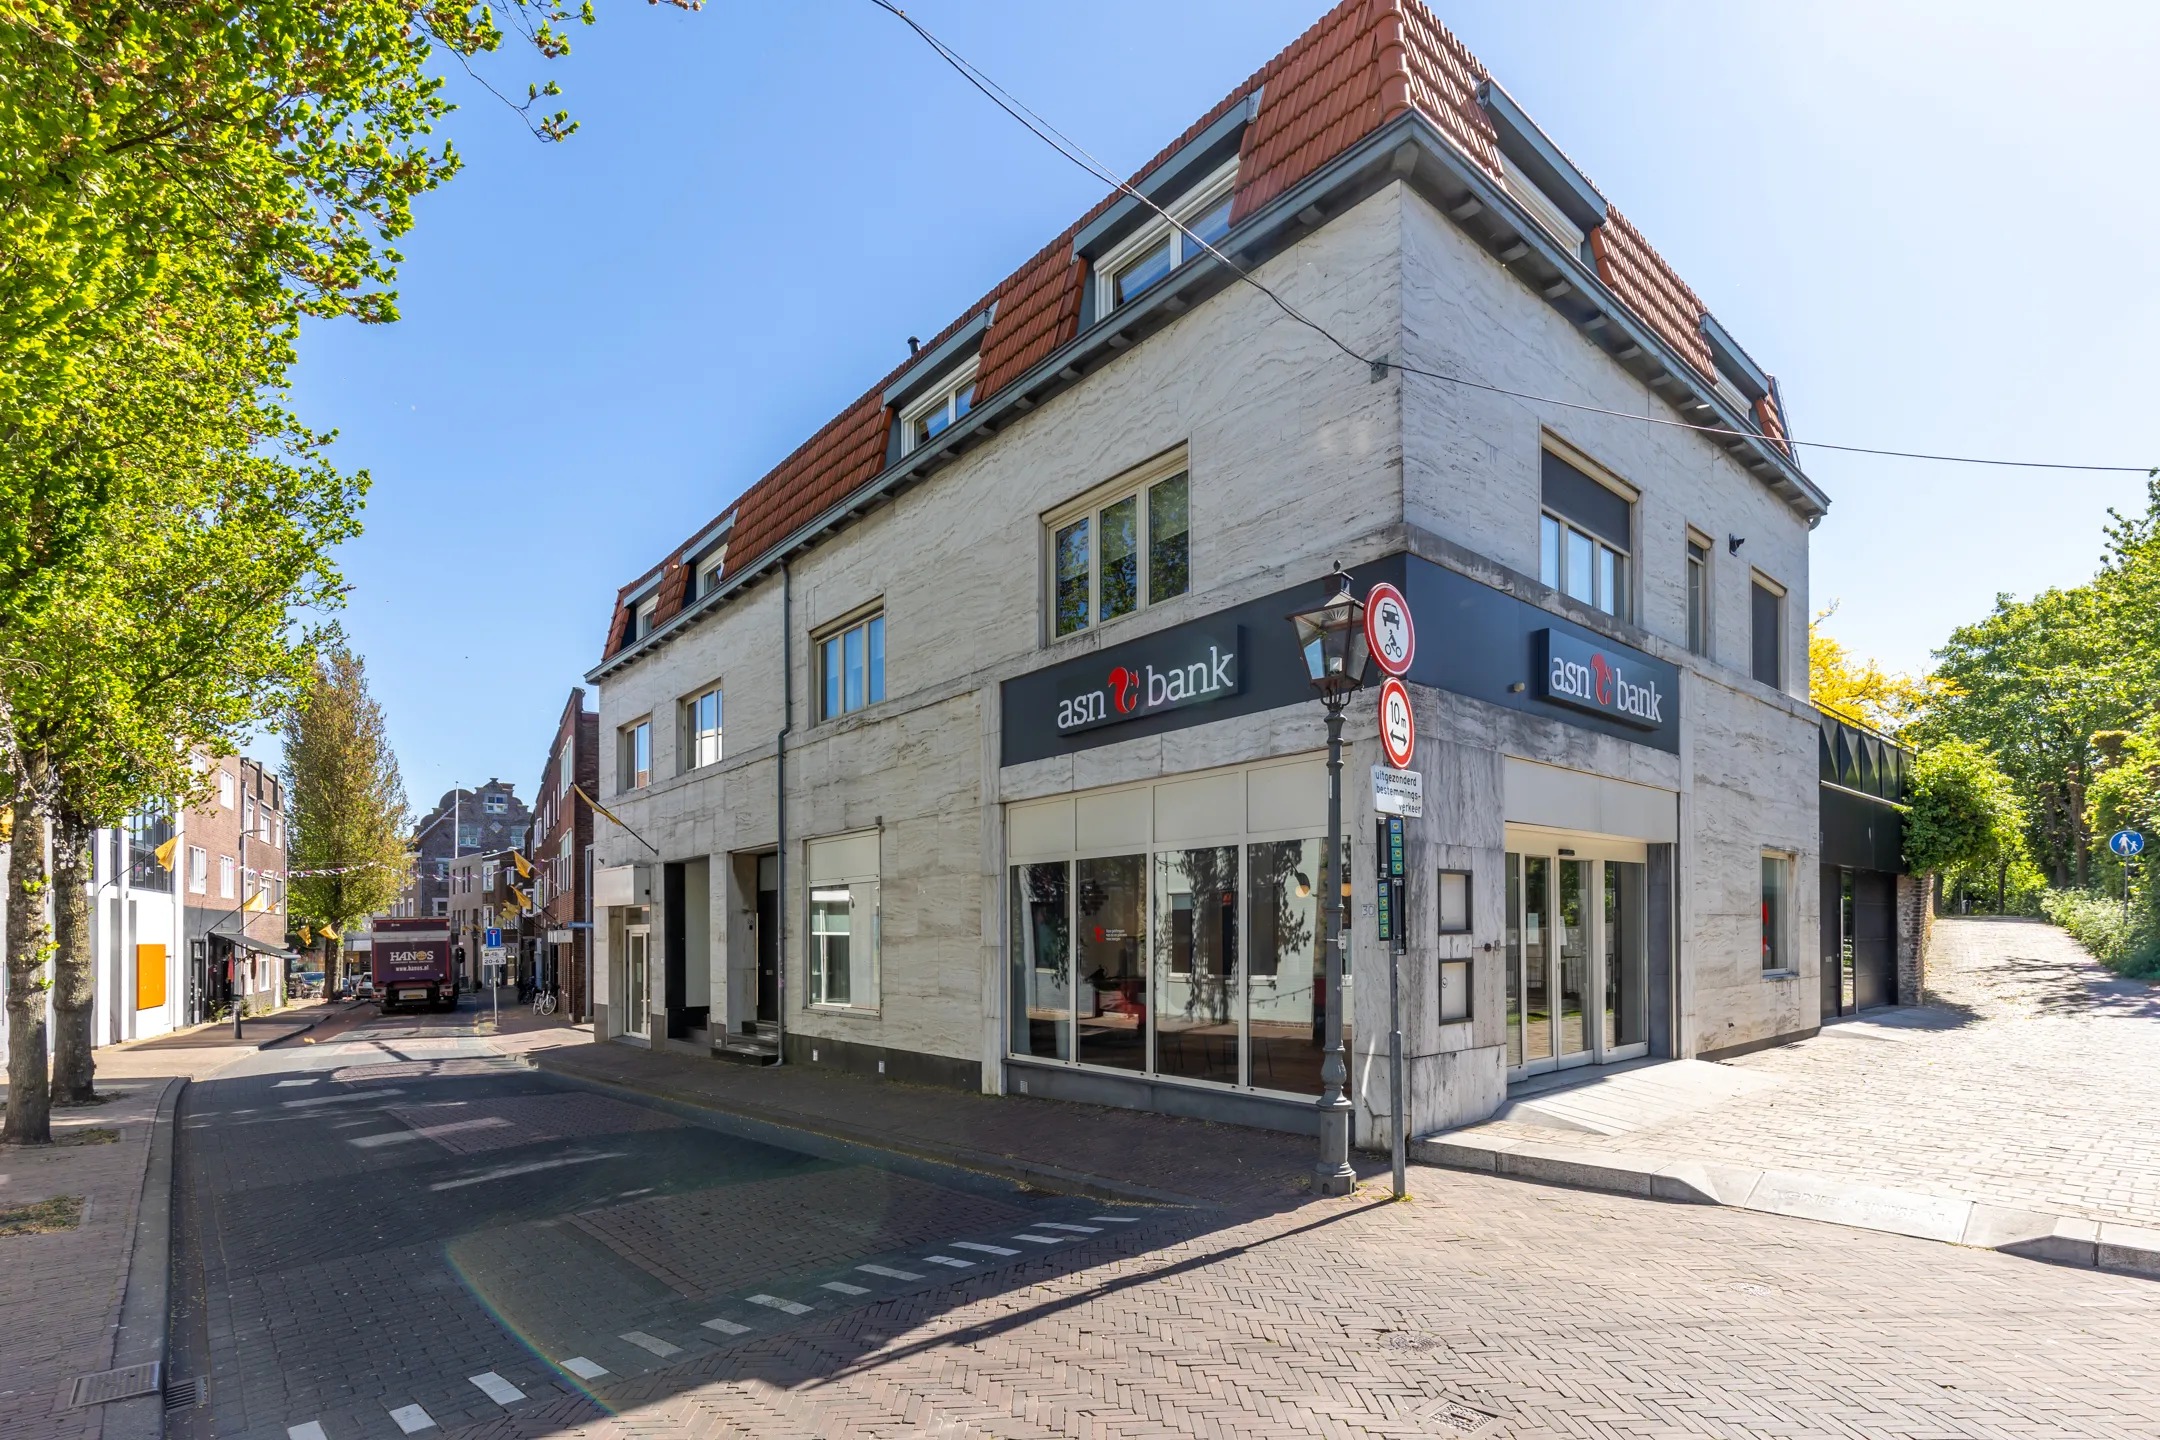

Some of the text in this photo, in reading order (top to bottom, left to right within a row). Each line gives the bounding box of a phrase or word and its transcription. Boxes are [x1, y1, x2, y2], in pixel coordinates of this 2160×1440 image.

[1058, 646, 1234, 729] asn bank
[1551, 657, 1662, 722] asn bank
[1390, 700, 1407, 728] 10 m
[1375, 770, 1417, 786] uitgezonderd
[1376, 784, 1421, 802] bestemmings-
[1398, 802, 1421, 815] verkeer
[1362, 905, 1375, 916] 30
[389, 950, 434, 962] HANOS
[395, 964, 430, 972] www.hanos.nl
